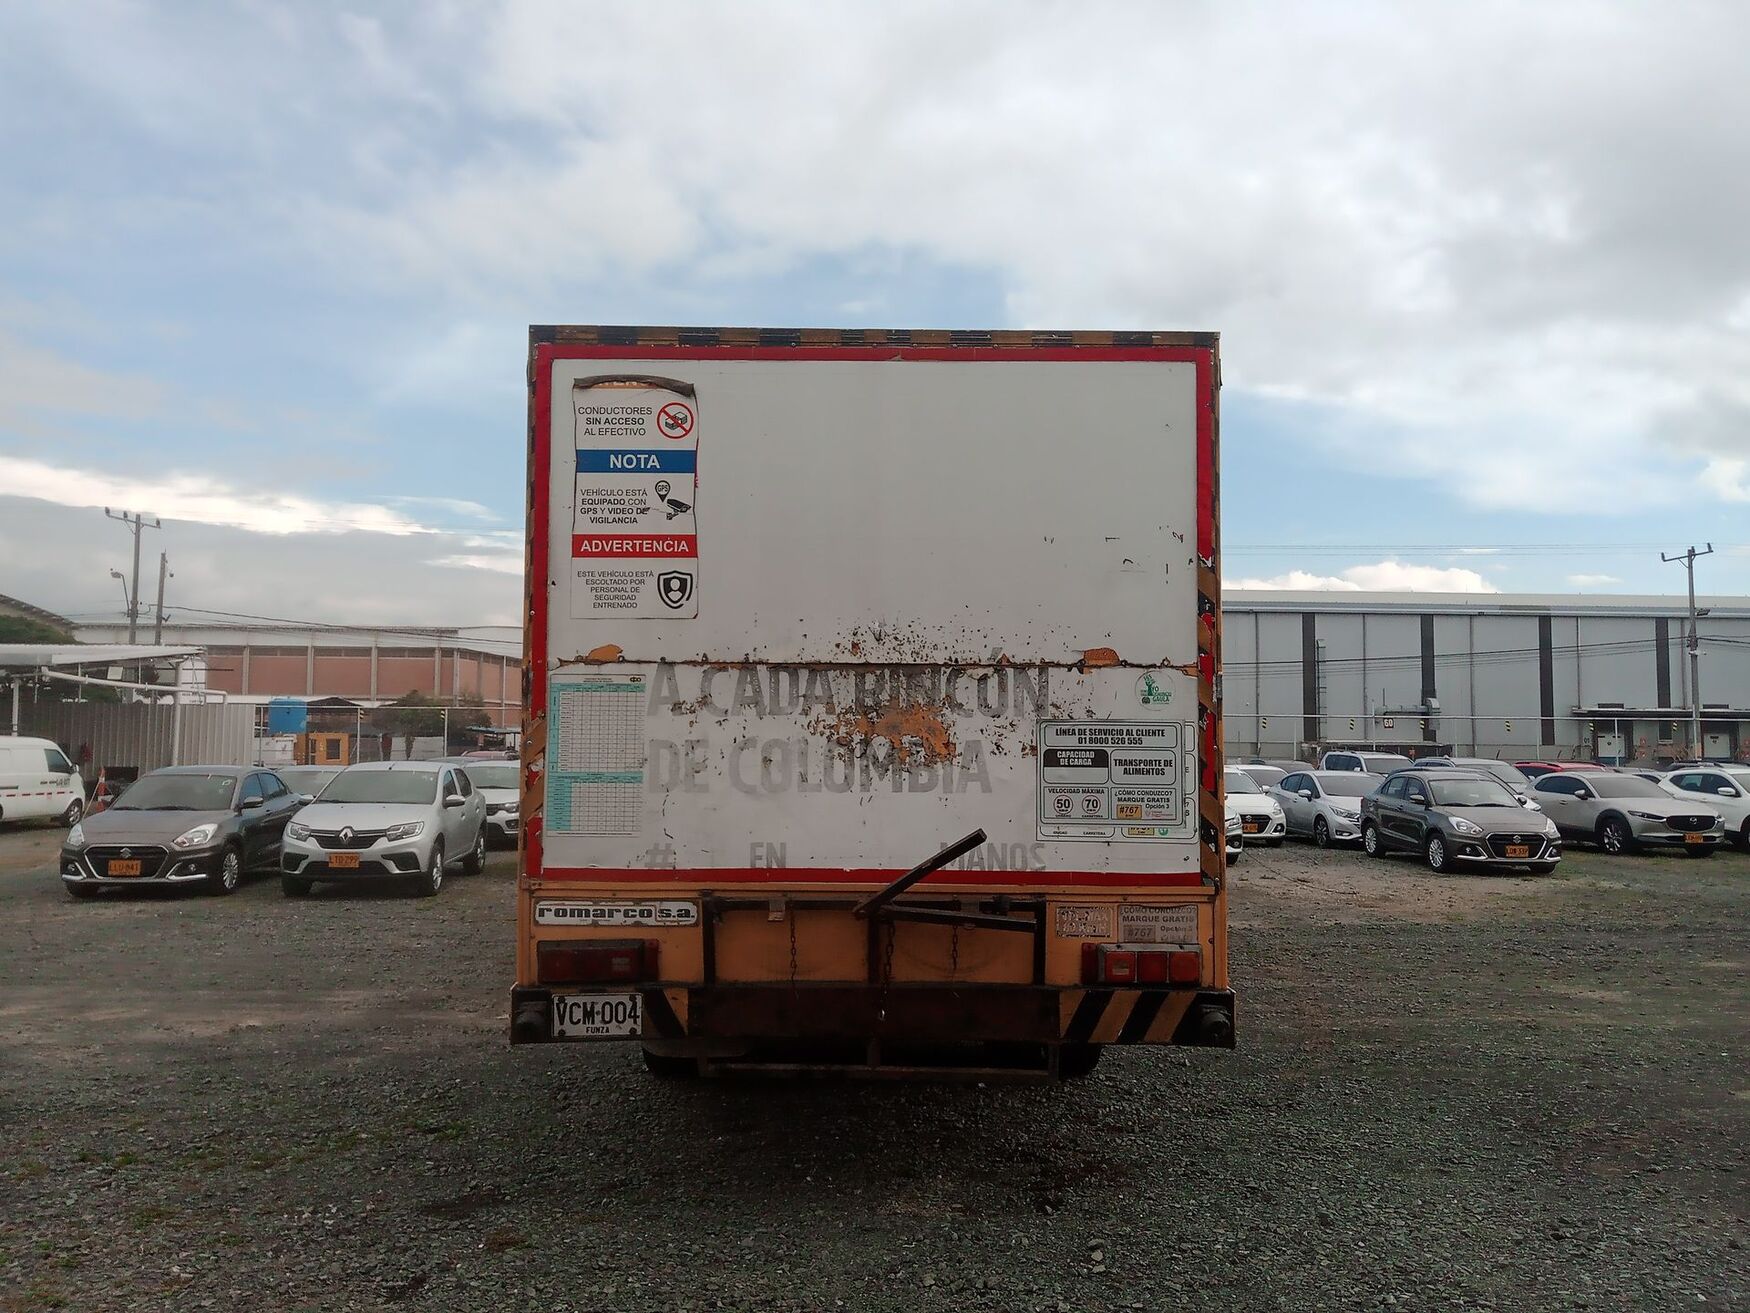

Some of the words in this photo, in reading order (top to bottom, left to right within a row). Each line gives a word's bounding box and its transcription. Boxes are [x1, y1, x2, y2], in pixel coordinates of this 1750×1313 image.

[578, 406, 653, 415] CONDUCTORES
[585, 417, 602, 425] SIN
[604, 417, 645, 425] ACCESO
[583, 427, 596, 436] AL
[598, 427, 647, 436] EFECTIVO
[609, 454, 661, 469] NOTA
[580, 487, 624, 496] VEHÍCULO
[625, 487, 648, 496] ESTÁ
[657, 484, 668, 492] GPS
[581, 498, 626, 506] EQUIPADO
[627, 498, 647, 506] CON
[580, 507, 598, 515] GPS
[600, 507, 606, 515] Y
[608, 507, 634, 515] VIDEO
[636, 507, 648, 515] DE
[589, 516, 638, 524] VIGILANCIA
[580, 540, 689, 552] ADVERTENCIA
[577, 570, 597, 578] ESTE
[597, 569, 634, 578] VEHÍCULO
[635, 569, 655, 578] ESTÁ
[585, 578, 629, 586] ESCOLTADO
[630, 578, 646, 586] POR
[592, 601, 638, 609] ENTRENADO
[647, 663, 684, 716] A
[699, 664, 836, 718] CADA
[1055, 727, 1076, 737] LÍNEA
[1078, 728, 1087, 737] DE
[1089, 728, 1124, 737] SERVICIO
[1125, 729, 1135, 737] AL
[1136, 729, 1165, 737] CLIENTE
[1078, 737, 1087, 745] 01
[1089, 737, 1109, 745] 8000
[1127, 737, 1143, 745] 555
[648, 738, 710, 794] DE
[1113, 758, 1162, 767] TRANSPORTE
[1163, 759, 1173, 767] DE
[1122, 767, 1166, 776] ALIMENTOS
[1056, 799, 1070, 809] 50
[1085, 799, 1098, 809] 70
[1119, 806, 1139, 814] #767
[538, 907, 653, 918] romarco
[657, 907, 695, 918] s.a.
[1122, 915, 1160, 923] MARQUE
[585, 1026, 610, 1034] FUNZA
